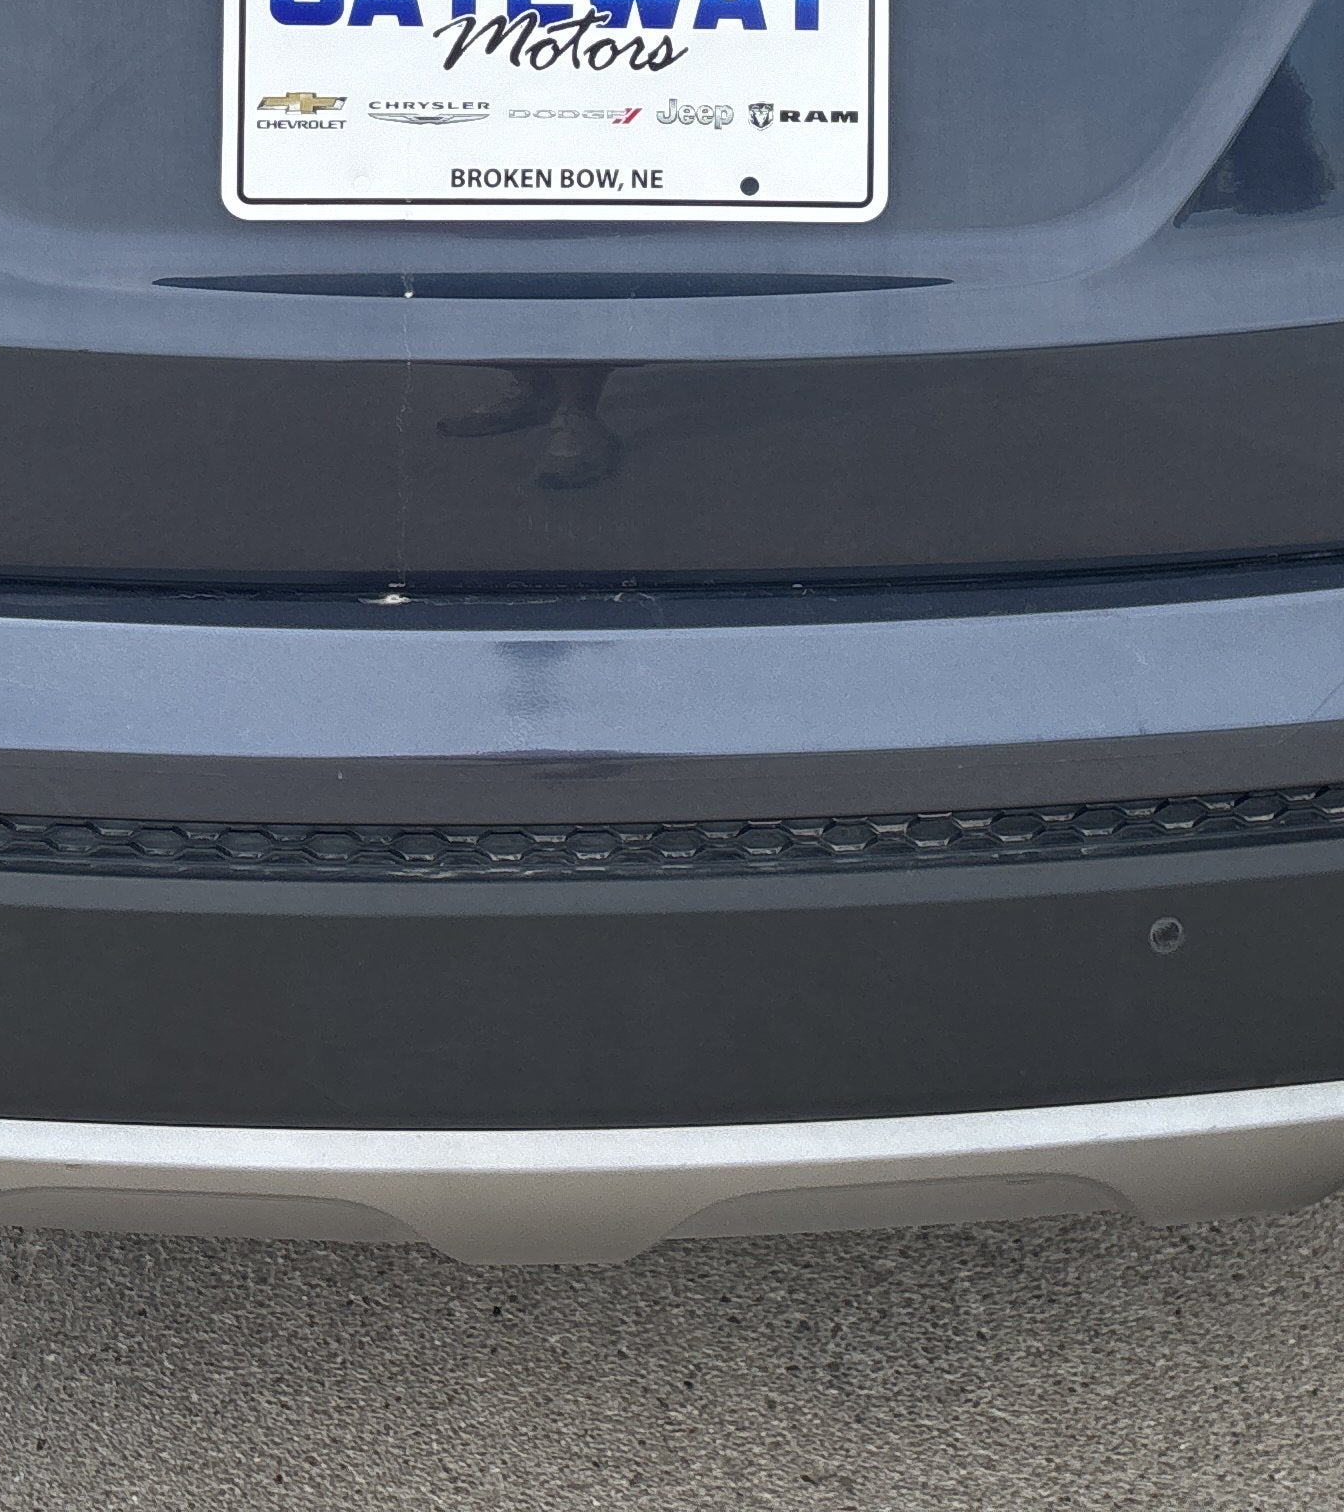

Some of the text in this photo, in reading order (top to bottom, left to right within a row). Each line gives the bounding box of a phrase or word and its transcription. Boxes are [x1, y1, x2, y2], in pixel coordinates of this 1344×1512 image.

[434, 9, 689, 71] Motors
[257, 120, 347, 130] CHEVROLET
[368, 101, 490, 110] CHRYSLER
[656, 99, 734, 130] Jeep
[779, 109, 859, 124] RAM
[451, 168, 664, 192] BROKEN BOW, NE
